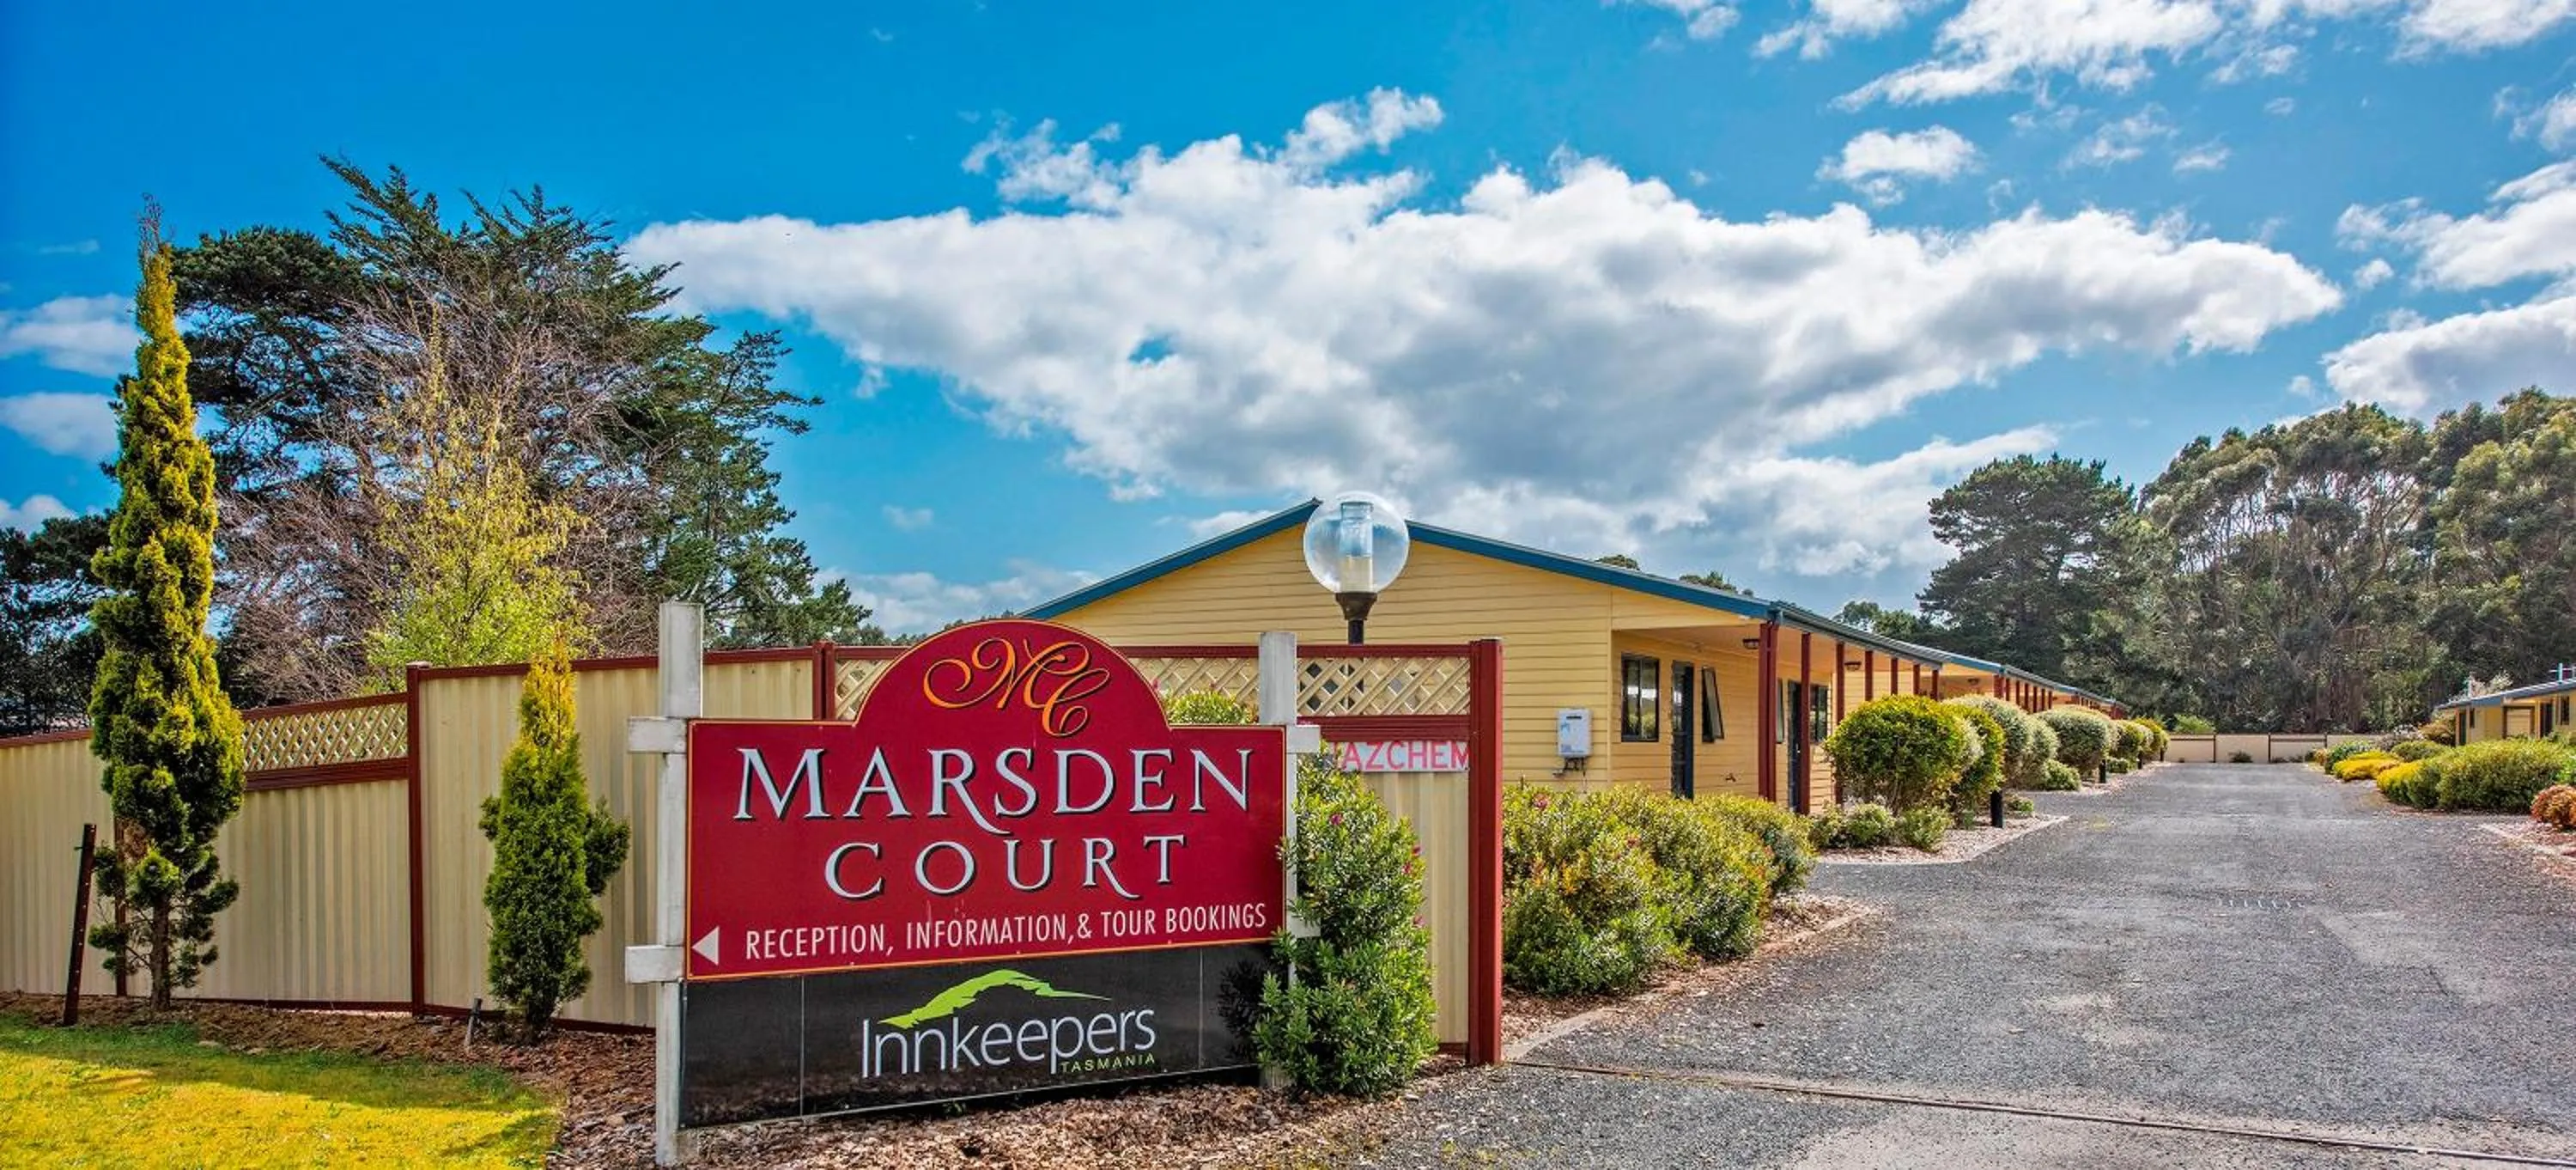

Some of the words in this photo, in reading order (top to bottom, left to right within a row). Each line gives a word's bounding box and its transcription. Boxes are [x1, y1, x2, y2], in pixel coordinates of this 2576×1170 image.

[1332, 741, 1471, 770] AZCHEM
[732, 746, 1251, 834] MARSDEN
[824, 835, 1187, 899] COURT
[746, 924, 894, 959] RECEPTION,
[1101, 910, 1157, 936] TOUR
[1166, 903, 1267, 931] BOOKINGS
[861, 1007, 1156, 1077] Innkeepers
[1060, 1052, 1156, 1073] TASMANIA
